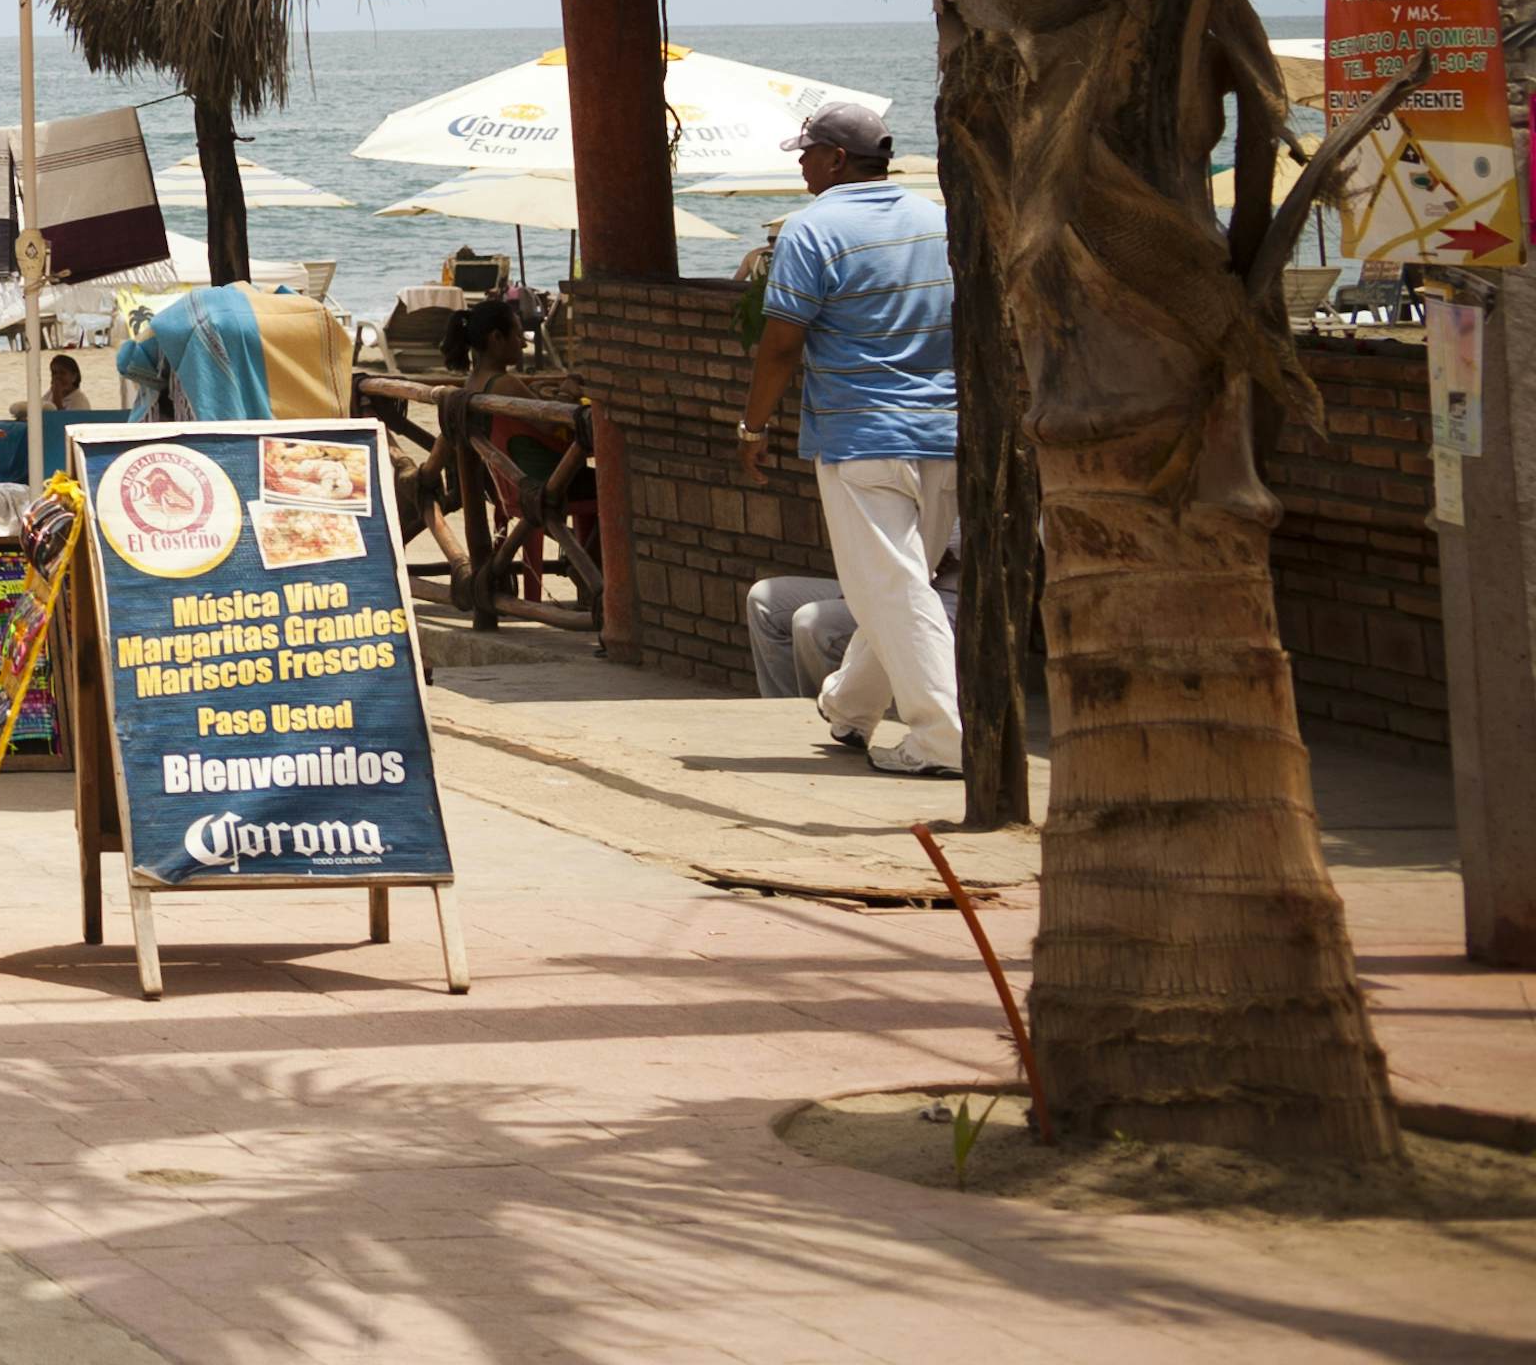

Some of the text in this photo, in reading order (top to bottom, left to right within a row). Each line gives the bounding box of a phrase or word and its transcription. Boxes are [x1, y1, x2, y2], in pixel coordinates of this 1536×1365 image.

[1391, 5, 1403, 23] Y
[1397, 29, 1413, 50] A
[448, 114, 560, 142] Corona
[127, 529, 221, 553] El Costeño
[172, 582, 349, 628] Música Viva
[117, 606, 409, 668] Margaritas Grandes
[136, 642, 396, 699] Mariscos Frescos
[197, 699, 354, 736] Pase Usted
[162, 746, 406, 794] Bienvenidos
[184, 811, 386, 873] Corona
